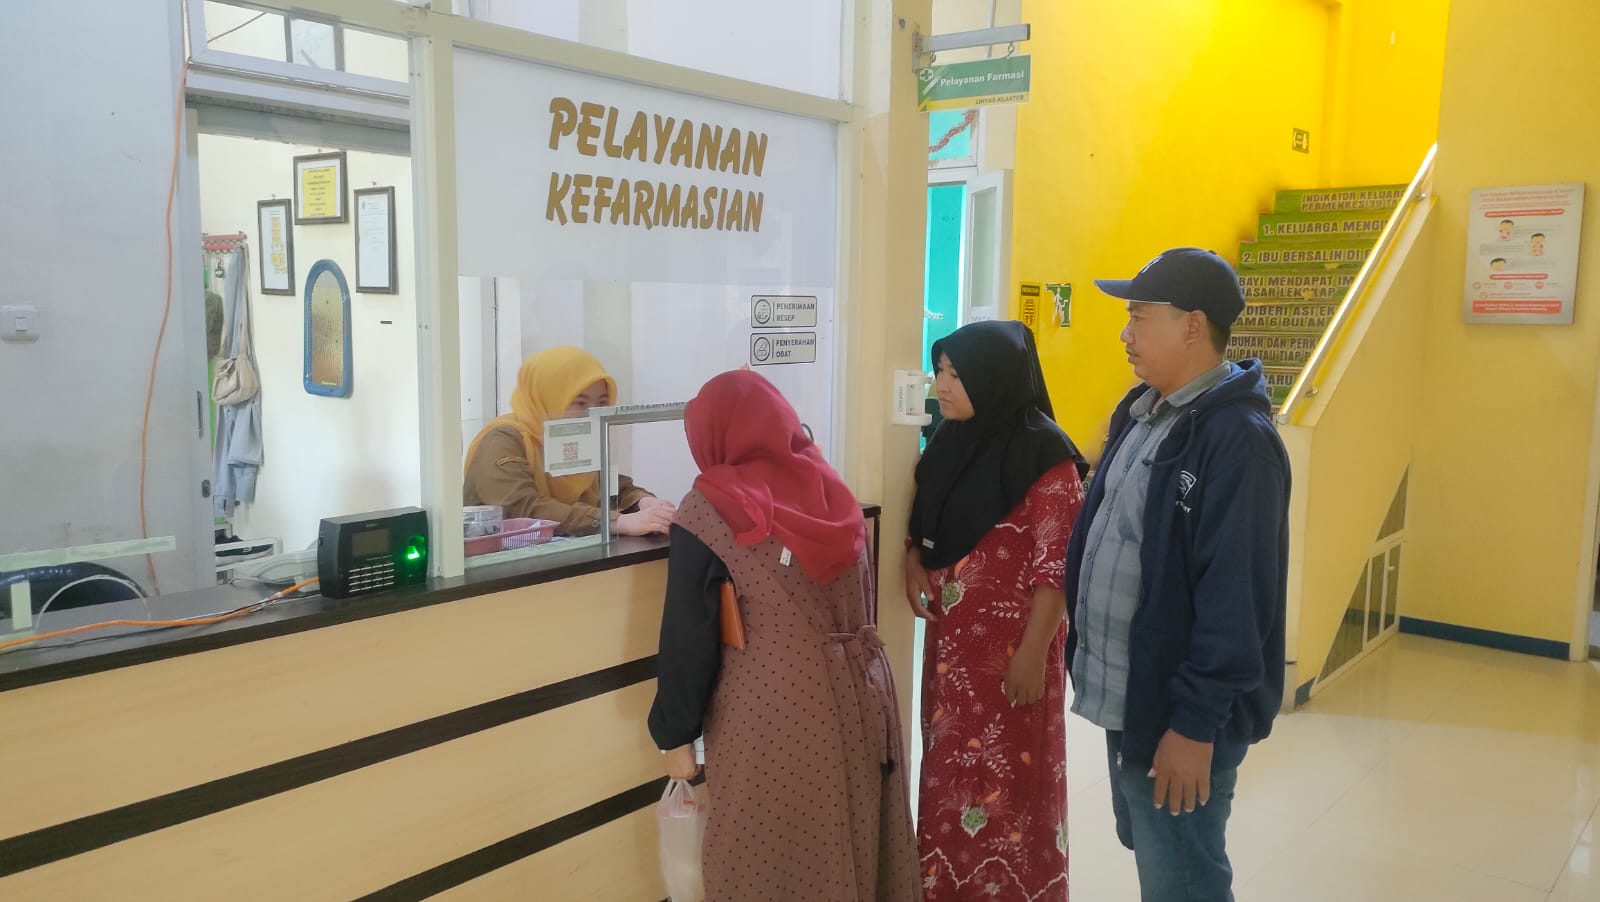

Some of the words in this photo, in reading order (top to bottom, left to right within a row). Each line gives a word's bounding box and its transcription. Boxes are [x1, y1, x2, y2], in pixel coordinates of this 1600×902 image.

[940, 74, 985, 87] Pelayanan
[987, 70, 1024, 81] Farmasi
[548, 97, 768, 177] PELAYANAN
[545, 171, 764, 232] KEFARMASIAN
[1277, 222, 1338, 233] KELUARGA
[1343, 219, 1388, 231] MENGI
[1258, 251, 1279, 262] IBU
[1283, 249, 1342, 261] BERSALIN
[1267, 276, 1333, 287] MENDAPAT
[1246, 305, 1288, 316] DIBERI
[1293, 305, 1314, 316] ASI
[1233, 317, 1264, 327] AMA
[1269, 317, 1277, 327] 6
[1282, 317, 1326, 327] BULAN
[776, 338, 815, 347] PENYERAHAN
[1228, 336, 1263, 348] BUHAN
[1267, 337, 1286, 349] DAN
[775, 350, 791, 358] OBAT
[1264, 374, 1293, 386] ARU
